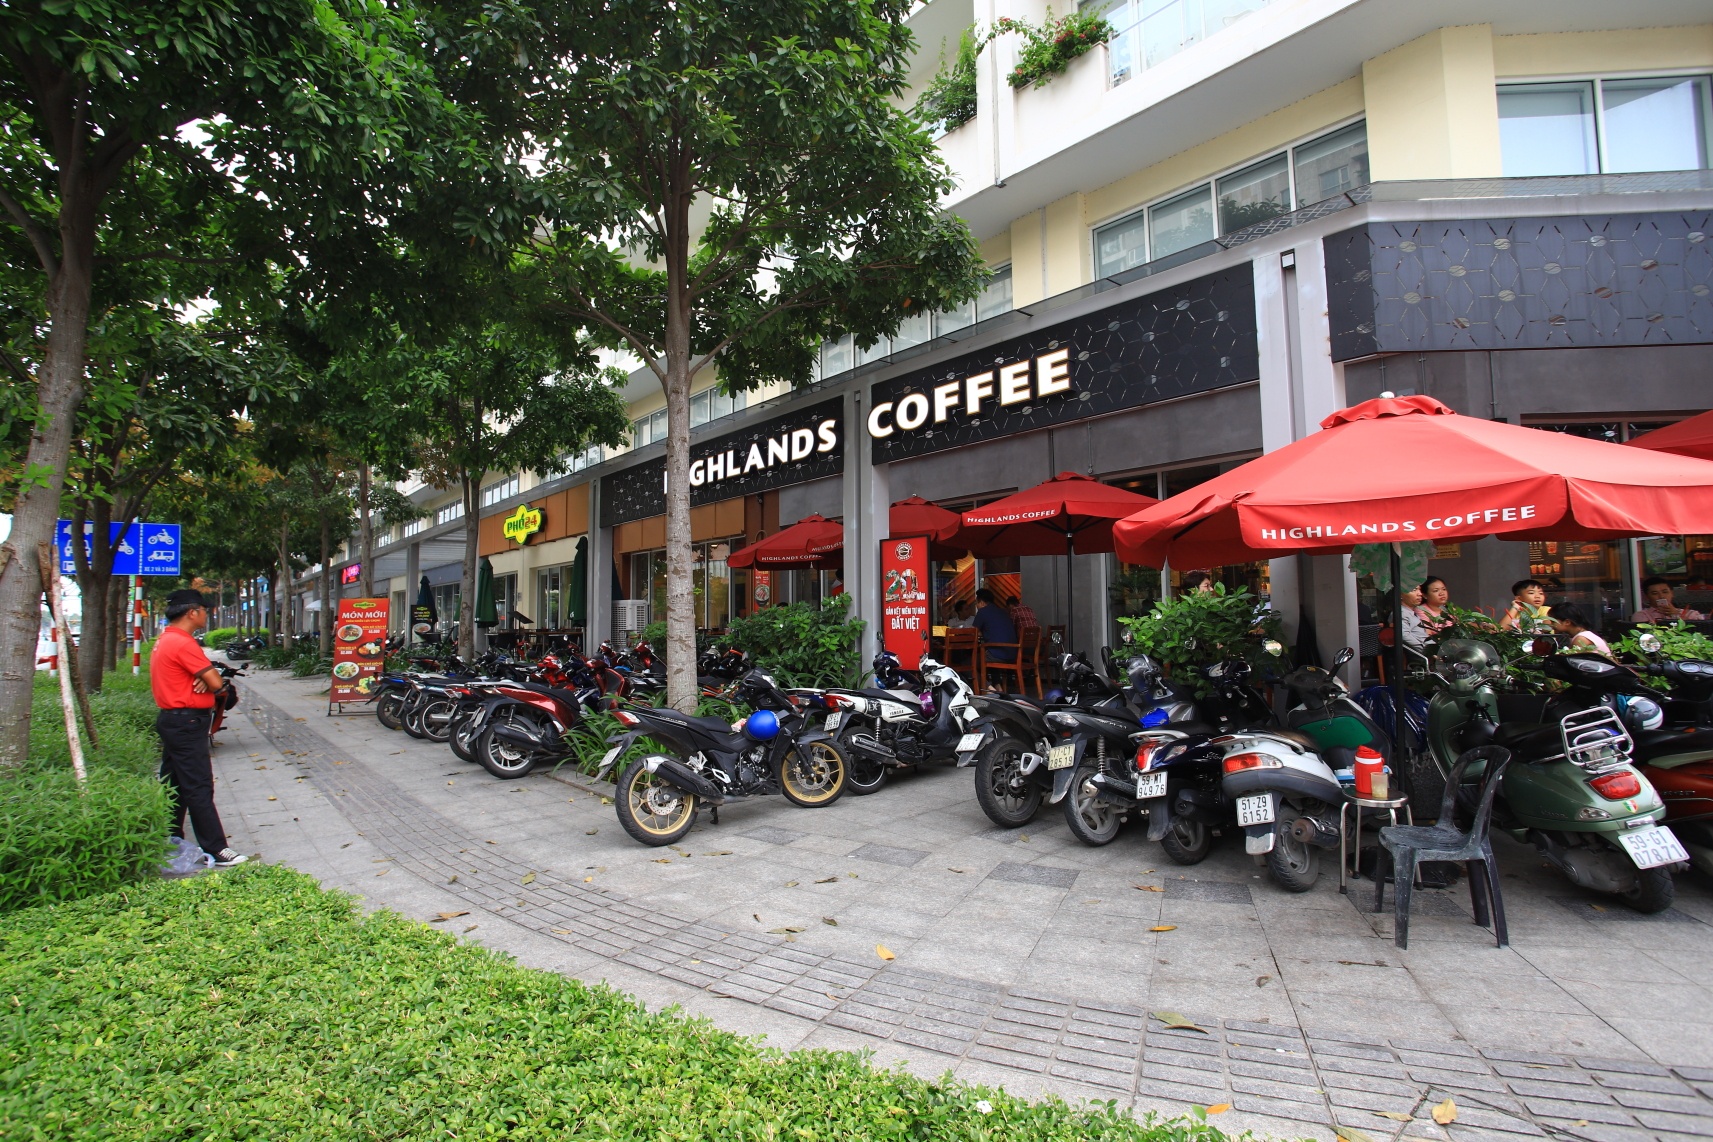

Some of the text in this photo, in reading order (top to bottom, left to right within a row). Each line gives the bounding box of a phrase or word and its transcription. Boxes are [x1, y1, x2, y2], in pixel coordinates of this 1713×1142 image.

[867, 347, 1071, 438] COFFEE
[664, 419, 837, 495] GHLANDS
[967, 509, 1055, 523] HIGHLANDS COFFEE
[1261, 504, 1536, 540] HIGHLANDS COFFEE
[365, 610, 386, 618] MỚI!
[892, 616, 919, 631] ĐẤT VIỆT
[1141, 773, 1162, 786] 59-M1
[1138, 784, 1165, 798] 949.76
[1241, 796, 1267, 811] 51-Z9
[1242, 808, 1269, 823] 6152
[1627, 830, 1668, 850] 59-G1
[1633, 844, 1683, 866] 078.71
